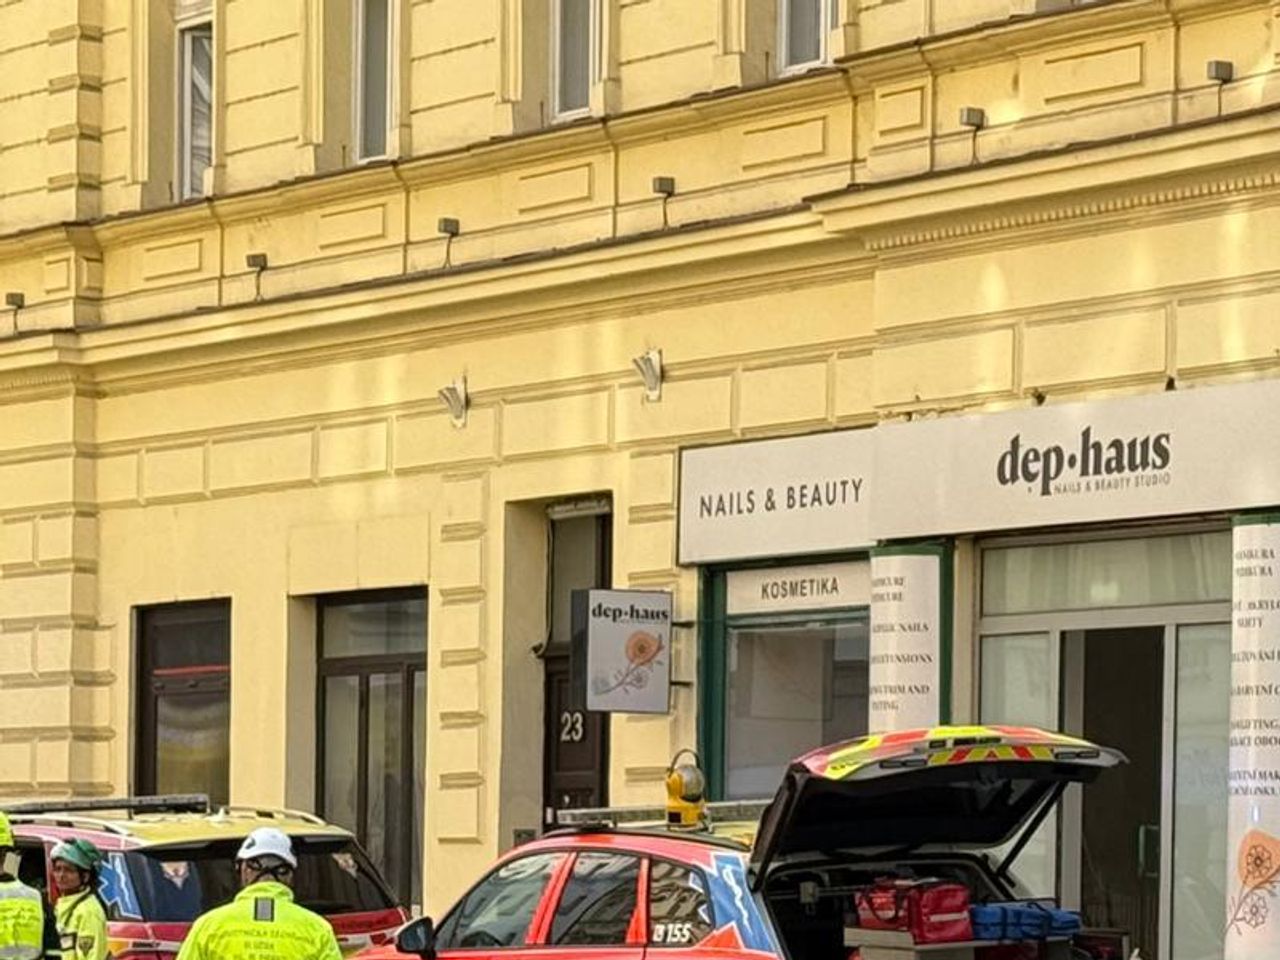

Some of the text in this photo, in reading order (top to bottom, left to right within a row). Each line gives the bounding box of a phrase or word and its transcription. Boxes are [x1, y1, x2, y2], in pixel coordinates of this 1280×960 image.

[1054, 482, 1081, 494] NAILS
[1095, 478, 1131, 491] BEAUTY
[1135, 473, 1171, 487] STUDIO
[699, 478, 863, 518] NAILS & BEAUTY
[761, 577, 839, 600] KOSMETIKA
[560, 712, 584, 741] 23
[666, 923, 692, 943] 155
